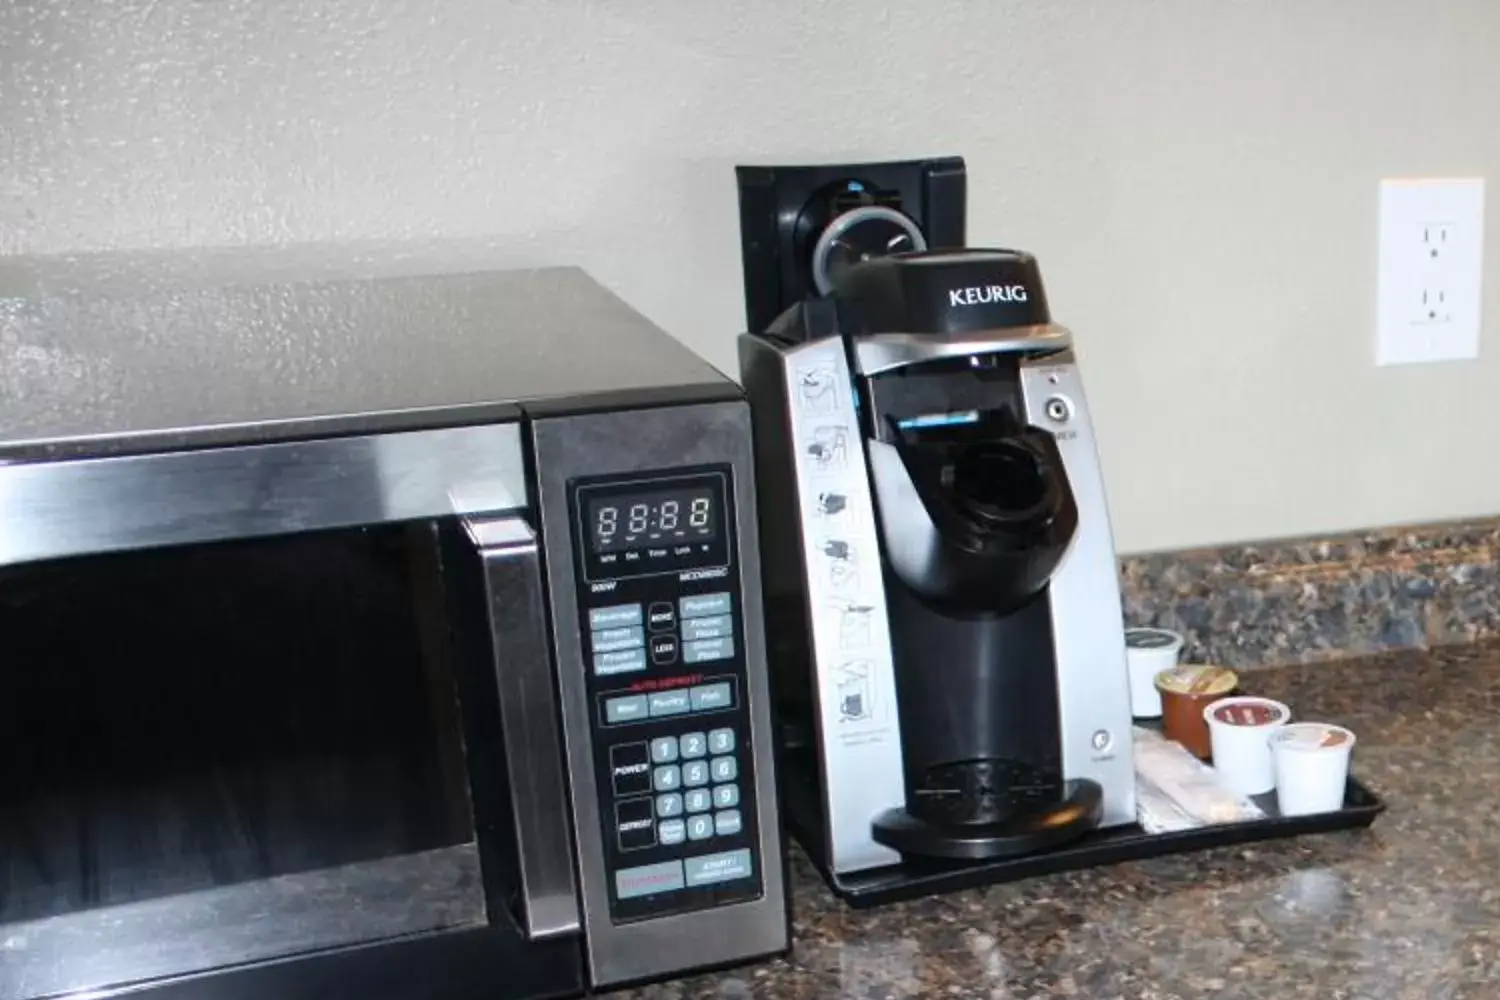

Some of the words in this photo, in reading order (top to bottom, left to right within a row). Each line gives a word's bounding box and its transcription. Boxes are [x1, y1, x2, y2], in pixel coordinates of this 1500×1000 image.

[949, 284, 1028, 307] KEURIG
[661, 742, 669, 757] 1
[688, 737, 699, 753] 2
[717, 733, 728, 749] 3
[613, 763, 648, 776] POWER
[662, 769, 673, 785] 4
[690, 766, 701, 781] 5
[719, 762, 729, 776] 6
[663, 797, 673, 814] 7
[693, 793, 703, 808] 8
[720, 789, 731, 803] 9
[695, 819, 704, 834] 0
